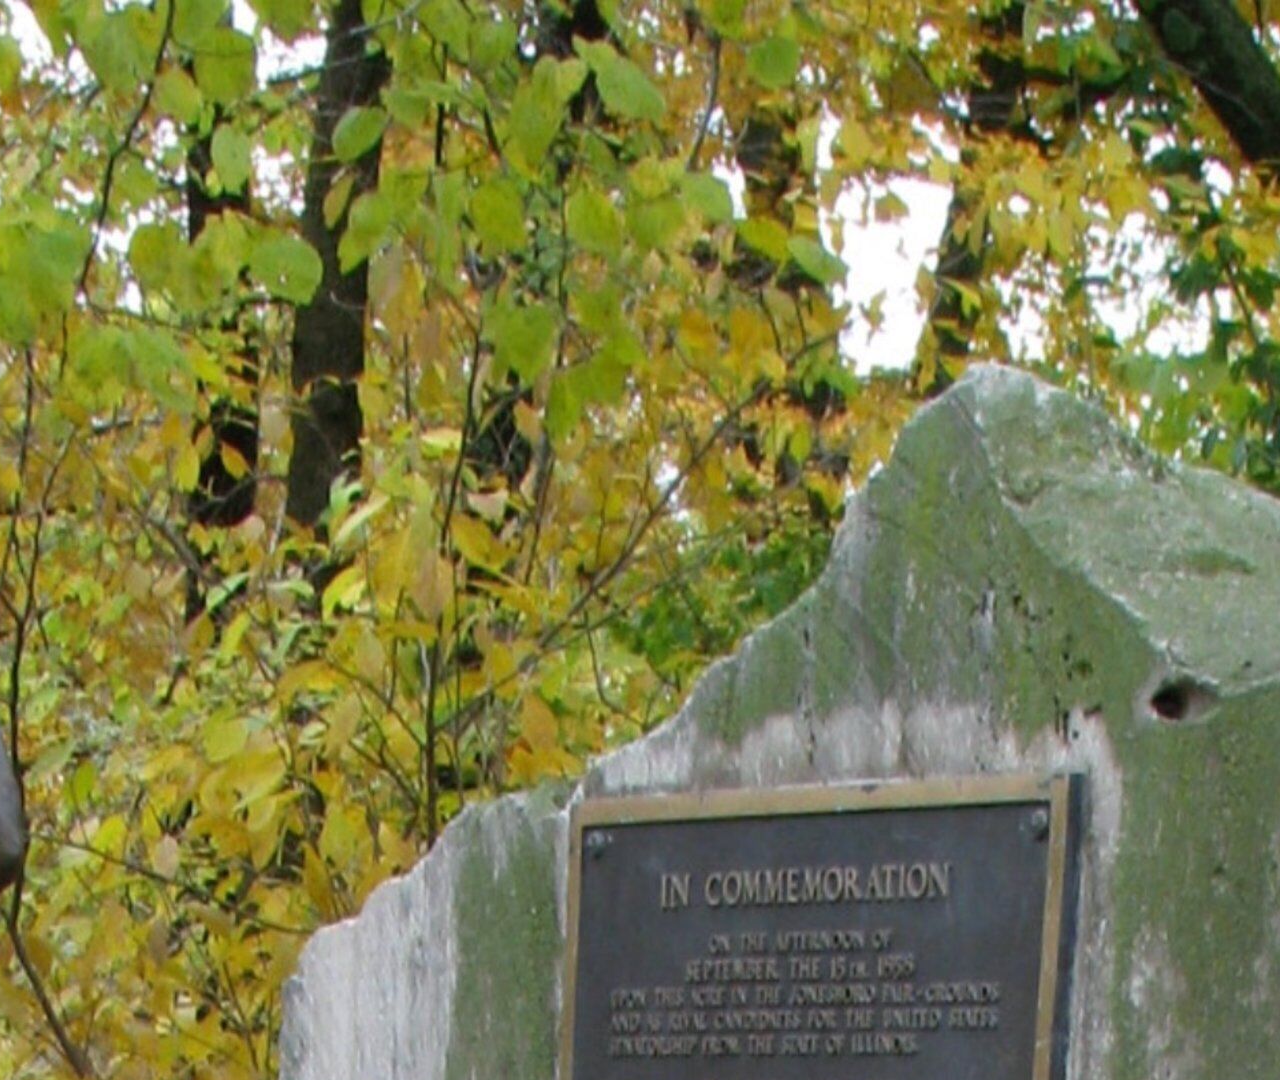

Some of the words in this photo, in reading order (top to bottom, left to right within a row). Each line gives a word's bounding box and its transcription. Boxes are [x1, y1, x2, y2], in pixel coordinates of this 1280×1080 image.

[659, 870, 690, 908] IN
[703, 861, 951, 907] COMMEMORATION
[707, 933, 730, 952] ON
[738, 929, 767, 949] THE
[774, 926, 864, 951] AFTERNOON
[871, 926, 892, 948] OF
[684, 954, 780, 981] SEPTEMBER
[788, 955, 820, 979] THE
[653, 984, 684, 1006] THIS
[730, 985, 746, 1003] IN
[755, 984, 781, 1003] THE
[786, 982, 876, 1005] JONESBORO
[611, 1011, 641, 1030] AND
[646, 1012, 661, 1030] AS
[668, 1010, 706, 1030] RIVAL
[713, 1007, 802, 1030] CANDIDATES
[806, 1008, 837, 1028] FOR
[845, 1007, 873, 1028] THE
[882, 1006, 942, 1028] UNITED
[946, 1006, 999, 1027] STATES
[747, 1033, 773, 1054] THE
[780, 1033, 819, 1054] STATE
[824, 1033, 844, 1053] OF
